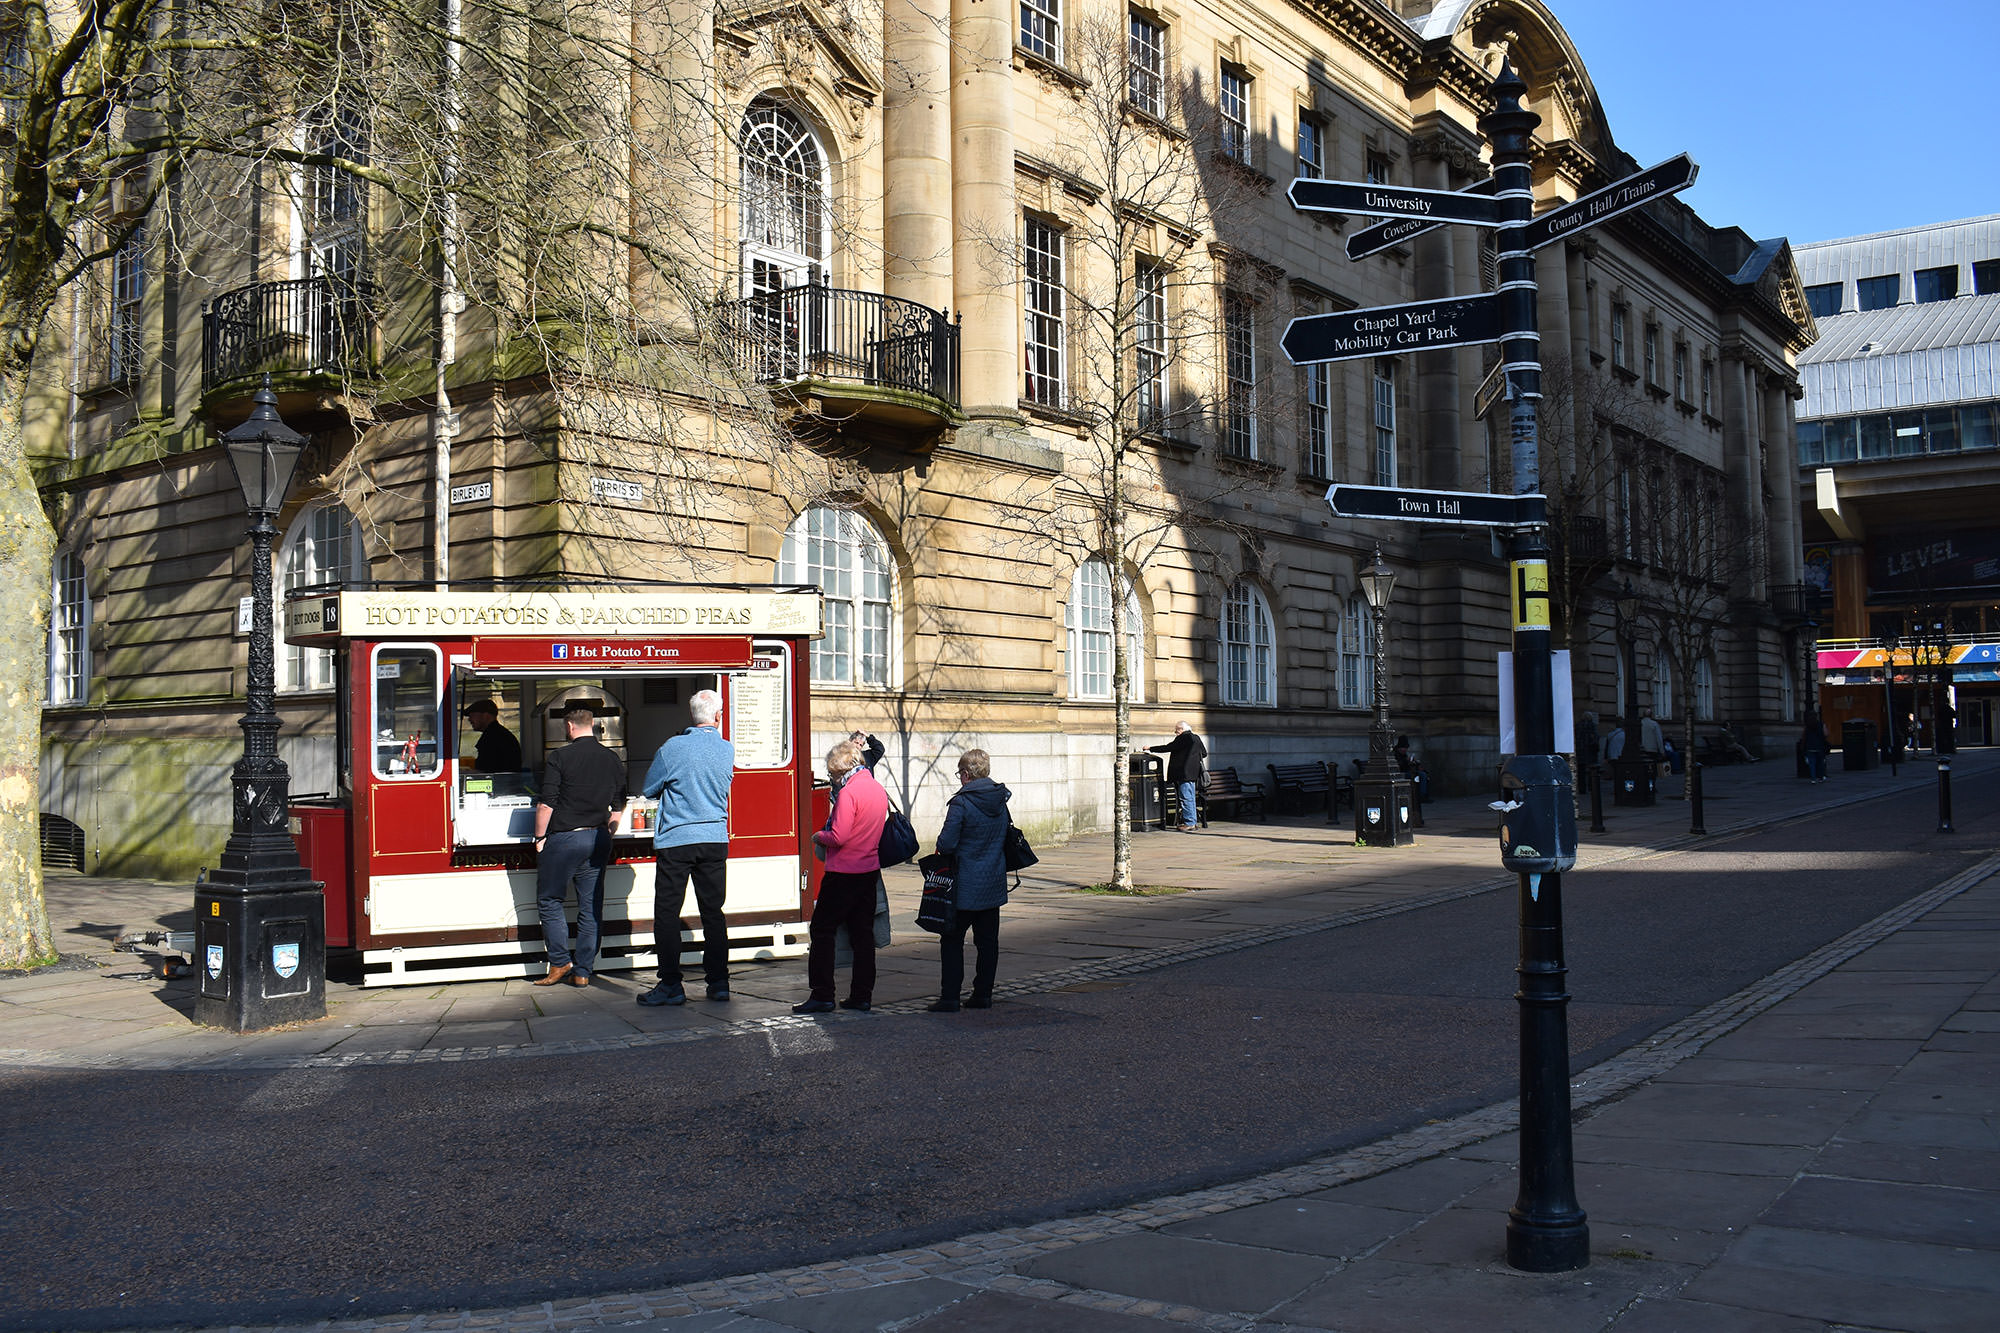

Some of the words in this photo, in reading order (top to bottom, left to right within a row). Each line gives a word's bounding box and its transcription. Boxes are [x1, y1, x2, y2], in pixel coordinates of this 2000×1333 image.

[1365, 192, 1432, 214] University
[1548, 211, 1584, 233] County
[1589, 179, 1656, 216] Hall/Trains
[1353, 314, 1399, 332] Chapel
[1405, 309, 1436, 325] Yard
[1334, 335, 1391, 352] Mobility
[1396, 331, 1421, 344] Car
[1427, 325, 1458, 340] Park
[452, 486, 478, 501] BIRLEY
[479, 485, 490, 497] ST.
[592, 481, 627, 495] HARRIS
[1398, 497, 1430, 512] Town
[1436, 500, 1460, 514] Hall
[1888, 540, 1959, 576] LEVEL
[294, 612, 304, 625] HOT
[304, 611, 320, 624] DOGS
[326, 607, 337, 622] 18
[366, 607, 420, 625] HOT
[426, 607, 549, 625] POTATOES
[556, 607, 576, 625] &
[581, 607, 691, 625] PARCHED
[695, 607, 753, 625] PEAS
[573, 645, 597, 657] Hot
[601, 645, 641, 657] Potato
[644, 645, 680, 657] Tram
[454, 852, 536, 868] PRESTON
